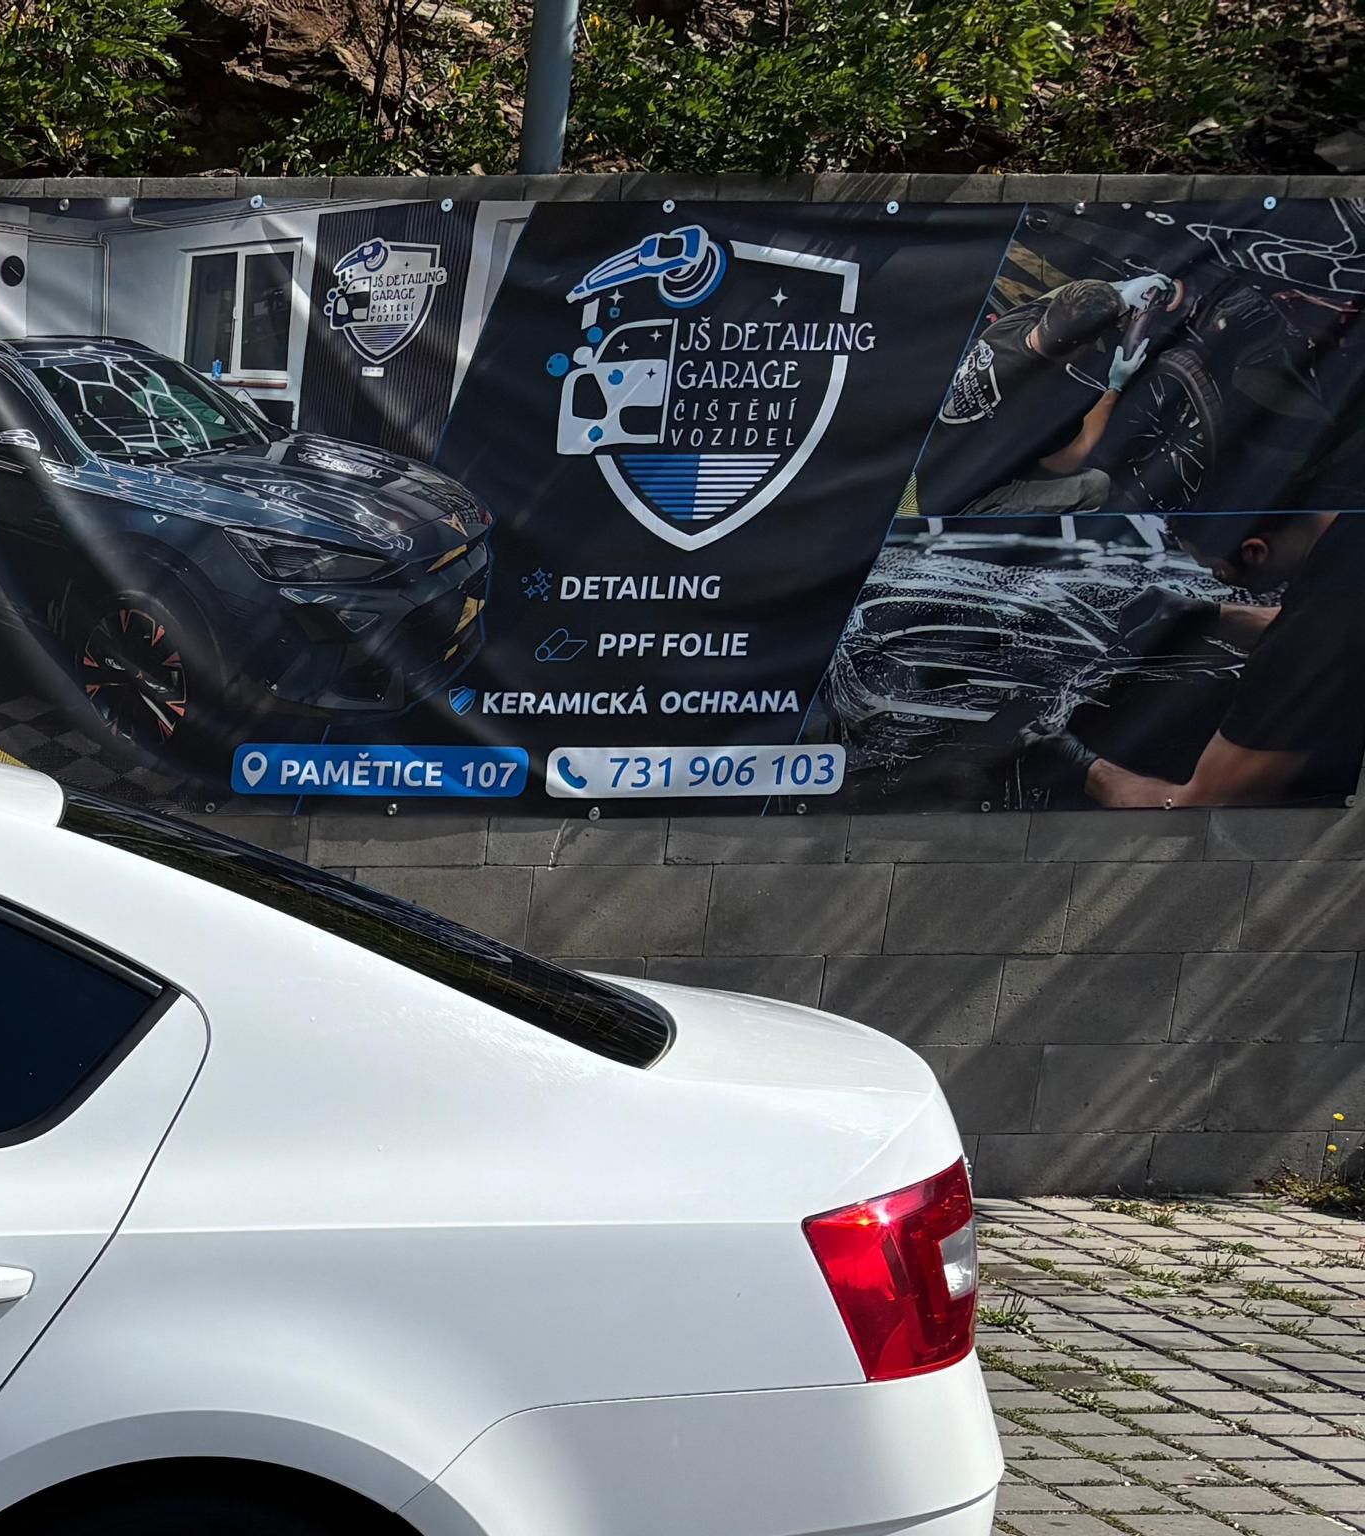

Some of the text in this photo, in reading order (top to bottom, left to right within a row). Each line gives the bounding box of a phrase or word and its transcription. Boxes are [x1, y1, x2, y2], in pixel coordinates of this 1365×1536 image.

[386, 270, 444, 287] DETAILING
[371, 288, 416, 301] GARAGE
[680, 316, 876, 352] JŠ DETAILING
[676, 360, 802, 390] GARAGE
[673, 397, 798, 422] ČIŠTĚNÍ
[671, 427, 796, 448] VOZIDEL
[559, 575, 721, 601] DETAILING
[597, 632, 749, 658] PPF FOLIE
[481, 685, 800, 715] KERAMICKÁ OCHRANA
[279, 752, 519, 788] PAMĚTICE 107
[608, 753, 836, 788] 731 906 103
